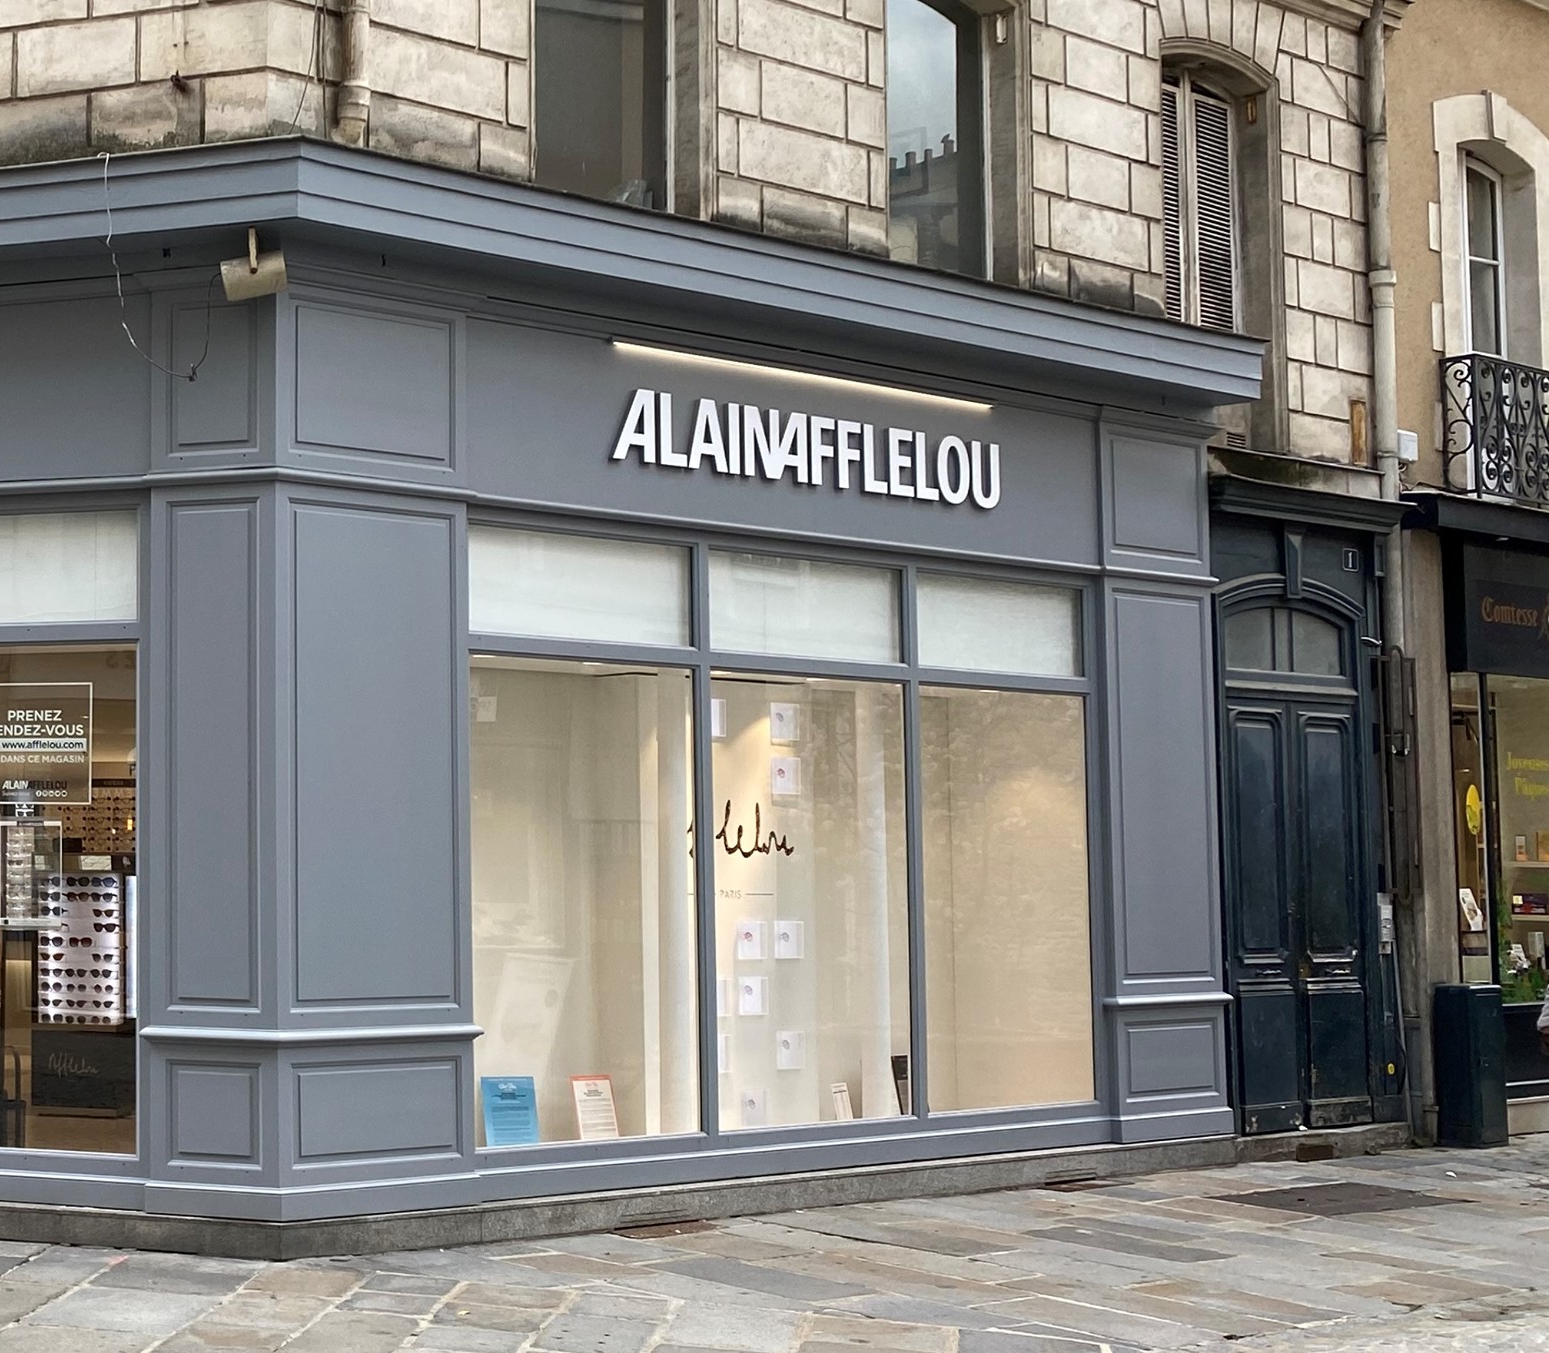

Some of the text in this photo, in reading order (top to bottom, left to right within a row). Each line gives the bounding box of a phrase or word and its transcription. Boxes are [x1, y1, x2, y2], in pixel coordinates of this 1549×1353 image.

[1480, 595, 1539, 627] Comtesse
[7, 710, 62, 722] PRENEZ
[1, 739, 84, 750] www.afflelou.com
[0, 755, 25, 763] DANS
[27, 755, 39, 763] CE
[41, 754, 85, 763] MAGASIN
[719, 889, 743, 900] PARIS
